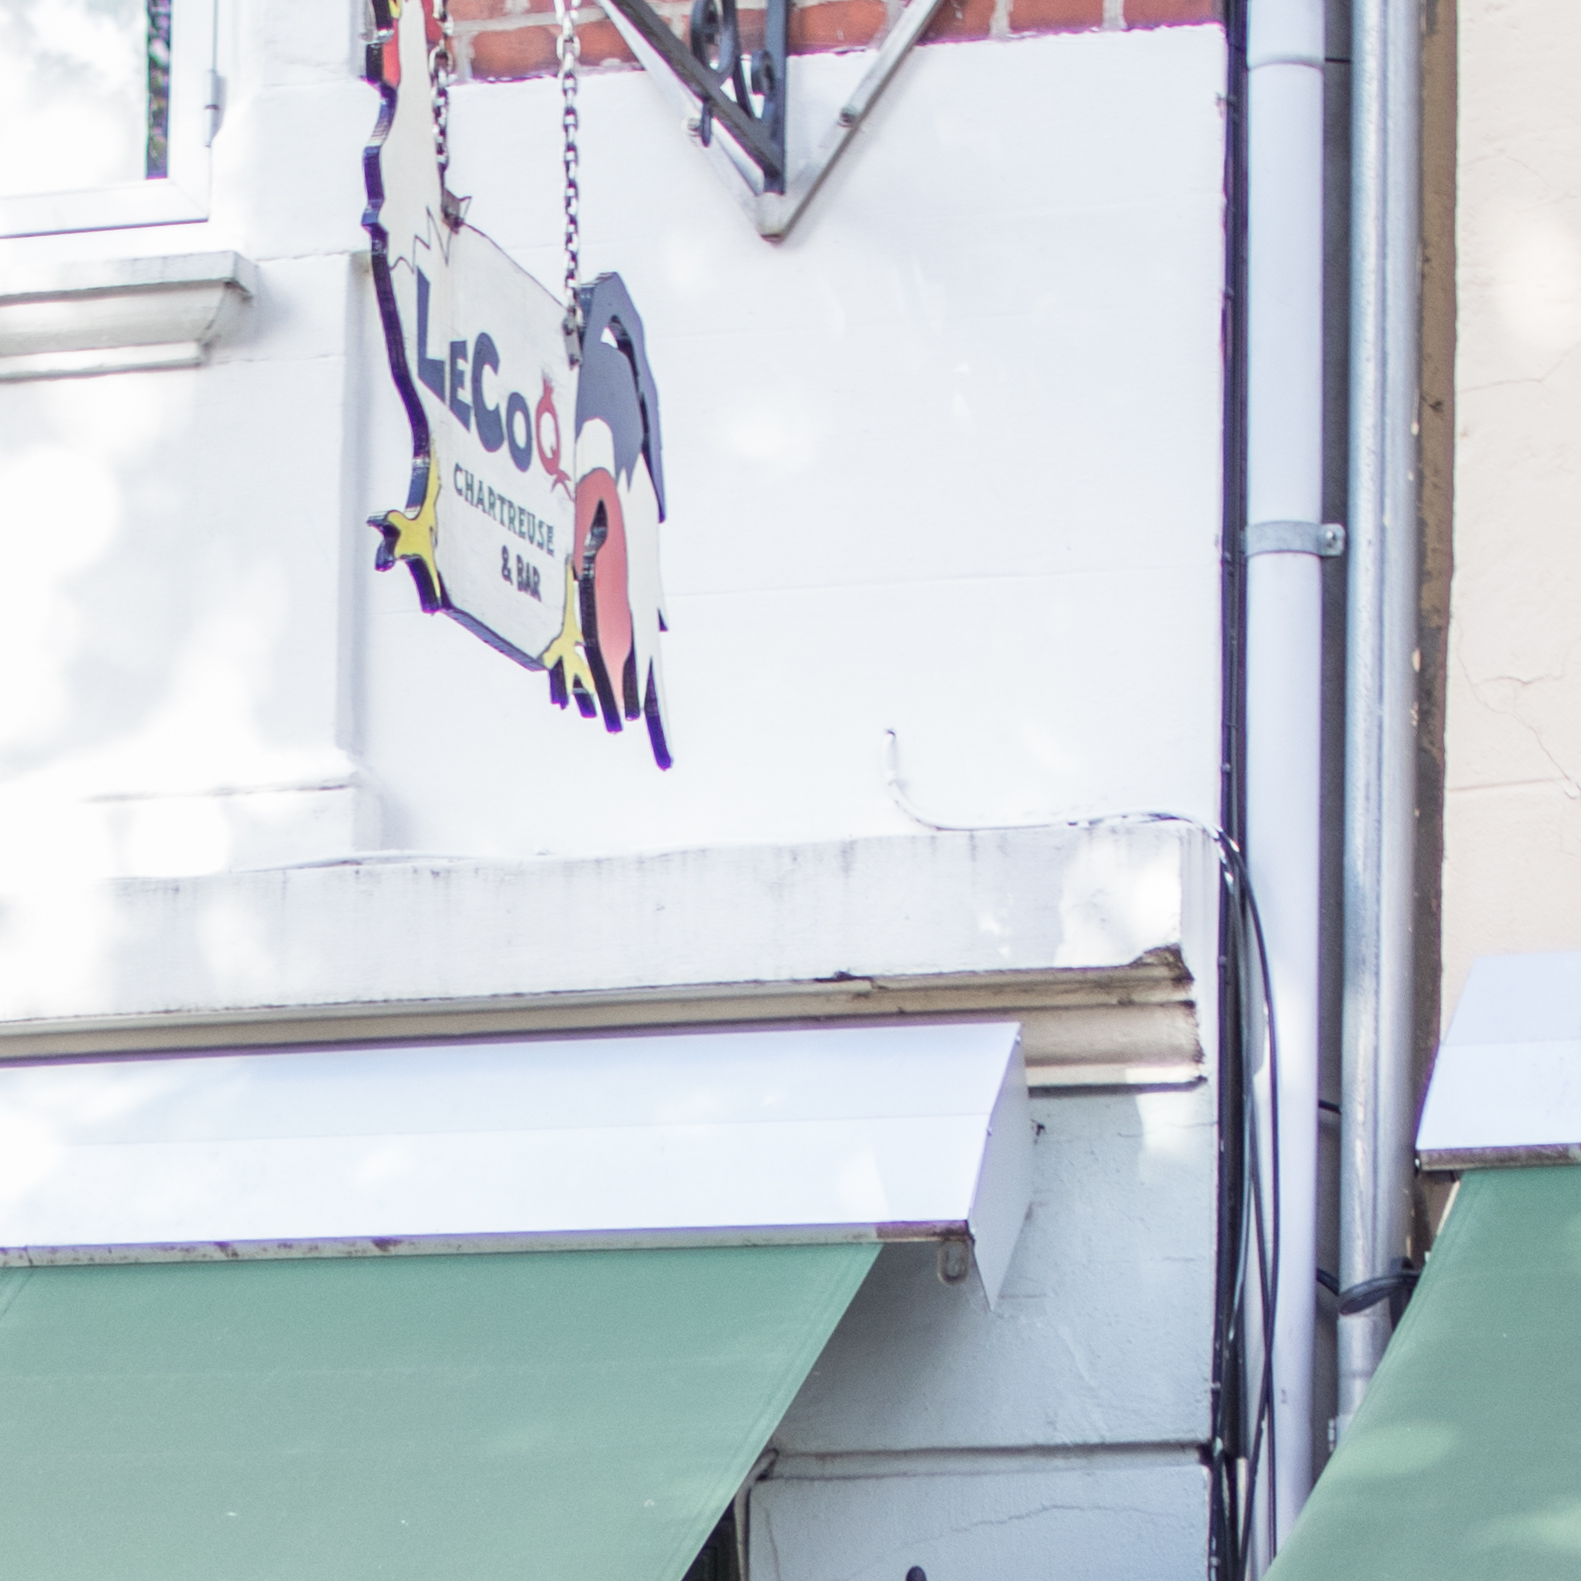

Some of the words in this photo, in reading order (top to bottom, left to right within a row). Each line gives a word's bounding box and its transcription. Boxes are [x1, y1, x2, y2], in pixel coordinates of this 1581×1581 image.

[453, 462, 555, 557] CHARTREUSE
[501, 545, 513, 586] &
[516, 554, 543, 602] BAR
